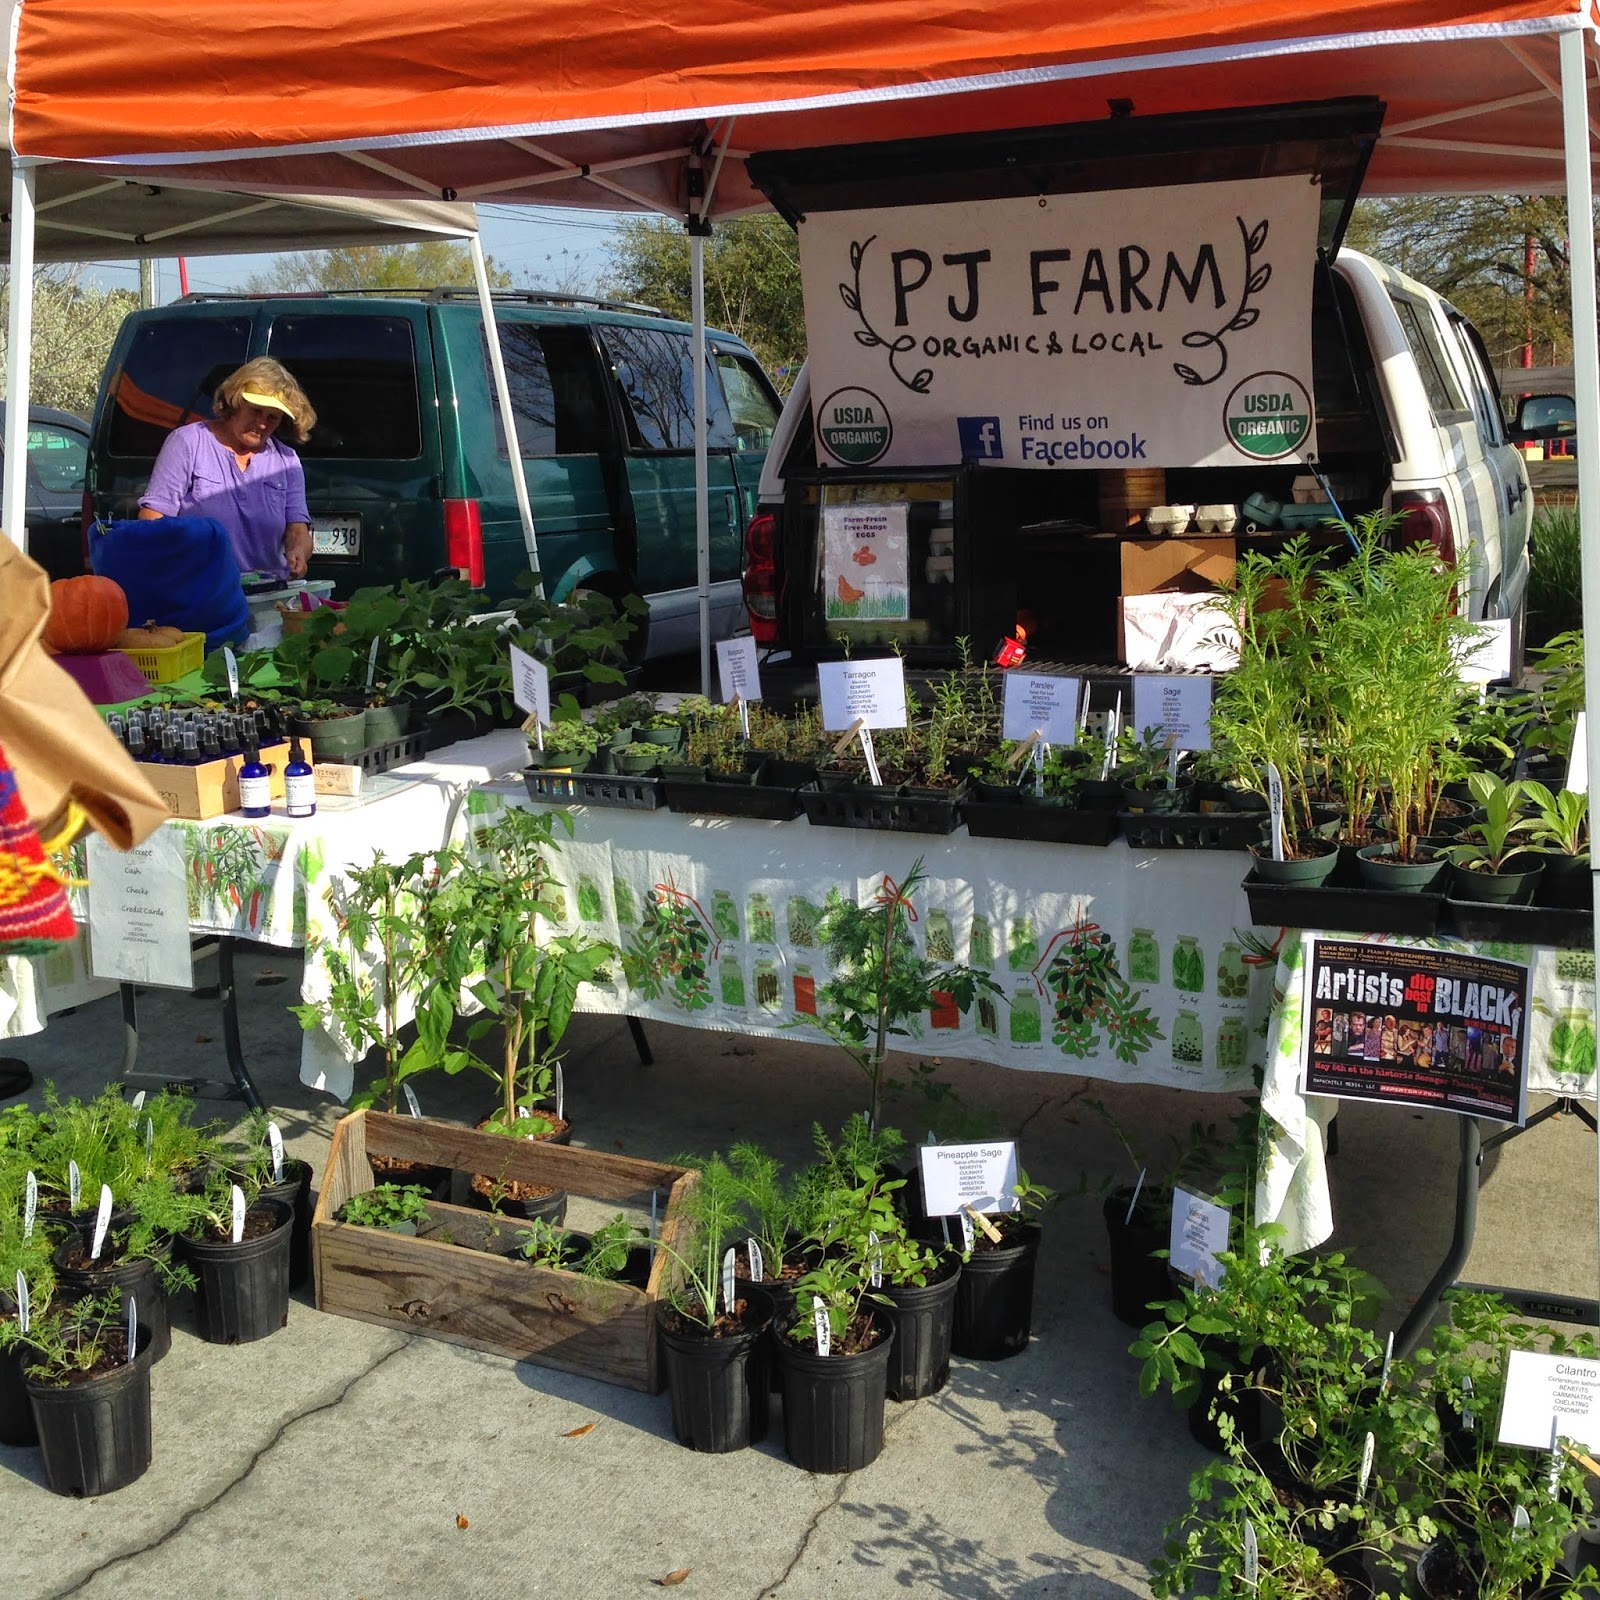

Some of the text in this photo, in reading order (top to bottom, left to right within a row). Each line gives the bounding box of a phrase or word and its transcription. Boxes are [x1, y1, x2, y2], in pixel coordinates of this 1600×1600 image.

[891, 243, 1227, 326] PJ FARM
[923, 334, 1039, 357] ORGANIC
[1072, 331, 1163, 357] LOCAL
[1244, 393, 1294, 413] USDA
[833, 407, 875, 425] USDA
[1018, 414, 1109, 431] Find us on
[1237, 418, 1300, 437] ORGANIC
[830, 430, 882, 445] ORGANIC
[1020, 433, 1147, 460] Facebook
[331, 527, 357, 546] 938
[843, 671, 876, 679] Tarragon
[1030, 681, 1055, 690] Parsley
[1163, 687, 1181, 696] Sage
[124, 867, 141, 875] Cash
[126, 886, 149, 895] Checks
[122, 905, 164, 916] Credit Cards
[1316, 966, 1404, 1007] Artists
[1410, 973, 1434, 991] die
[1405, 988, 1431, 1003] best
[1435, 977, 1517, 1027] BLACK
[1417, 1002, 1428, 1013] in
[1315, 1062, 1331, 1071] May
[1348, 1066, 1358, 1074] at
[1360, 1067, 1374, 1075] the
[1375, 1069, 1413, 1079] historic
[937, 1148, 1002, 1160] Pineapple Sage
[1531, 1303, 1576, 1315] LIFETIME
[1556, 1364, 1597, 1378] Cilantro
[1548, 1376, 1580, 1385] Coriandrum
[1552, 1391, 1593, 1401] CARMINATIVE
[1559, 1385, 1589, 1393] BENEFITS
[1553, 1406, 1589, 1415] CONDIMENT
[1555, 1399, 1589, 1408] CHELATING
